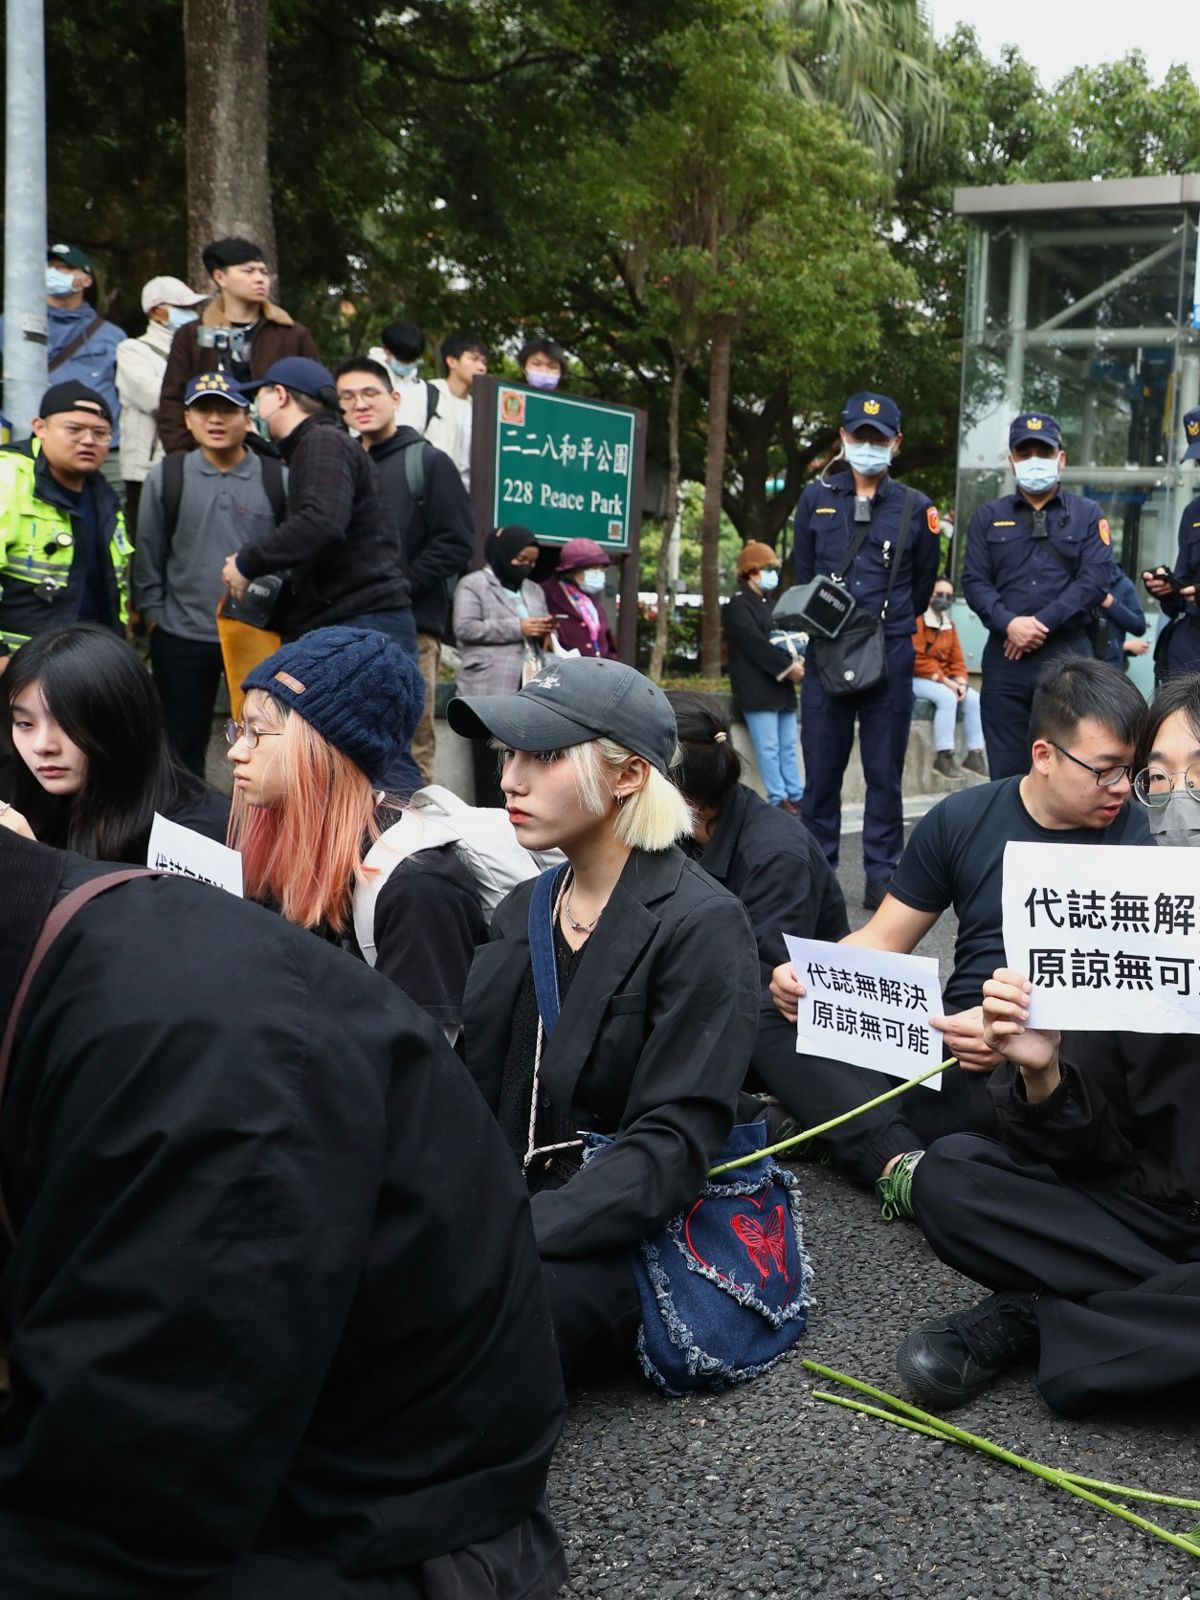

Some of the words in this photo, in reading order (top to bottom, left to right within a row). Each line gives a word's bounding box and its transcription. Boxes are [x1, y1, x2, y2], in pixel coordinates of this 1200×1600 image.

[502, 429, 629, 477] 二二八和平公園
[503, 478, 534, 505] 228
[540, 483, 584, 512] Peace
[590, 490, 623, 516] Park
[247, 583, 270, 597] PRO
[806, 962, 929, 1013] 代誌無解決
[812, 999, 930, 1055] 原諒無可能
